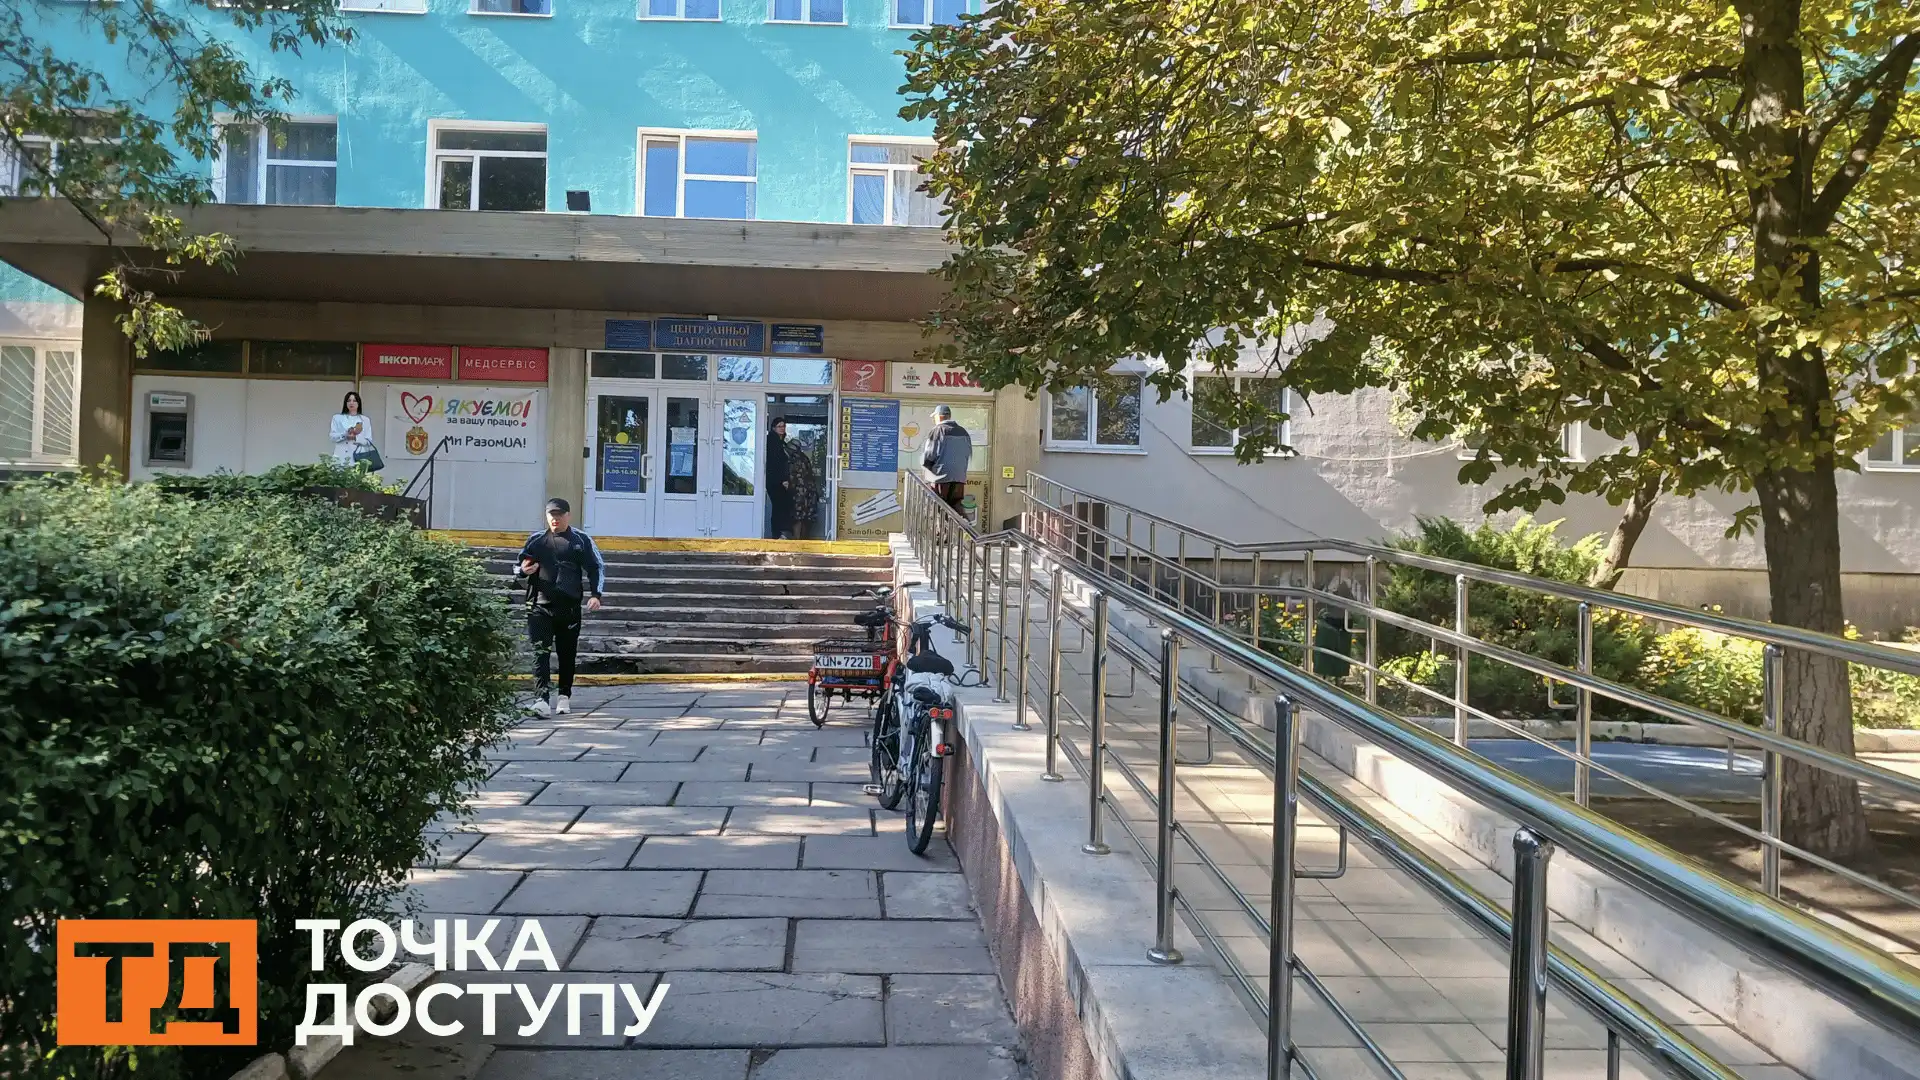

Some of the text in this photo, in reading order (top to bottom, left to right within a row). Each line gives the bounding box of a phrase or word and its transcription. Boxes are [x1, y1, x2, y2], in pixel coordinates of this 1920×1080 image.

[670, 324, 750, 336] ЦЕНТР РАННЬОЇ
[673, 336, 747, 348] ДІАГНОСТИКИ
[465, 358, 536, 369] МЕДСЕРВІС
[429, 397, 532, 427] ДЯКУЄМО!
[460, 418, 485, 427] вашу
[487, 418, 519, 428] працю
[445, 436, 462, 446] Ми
